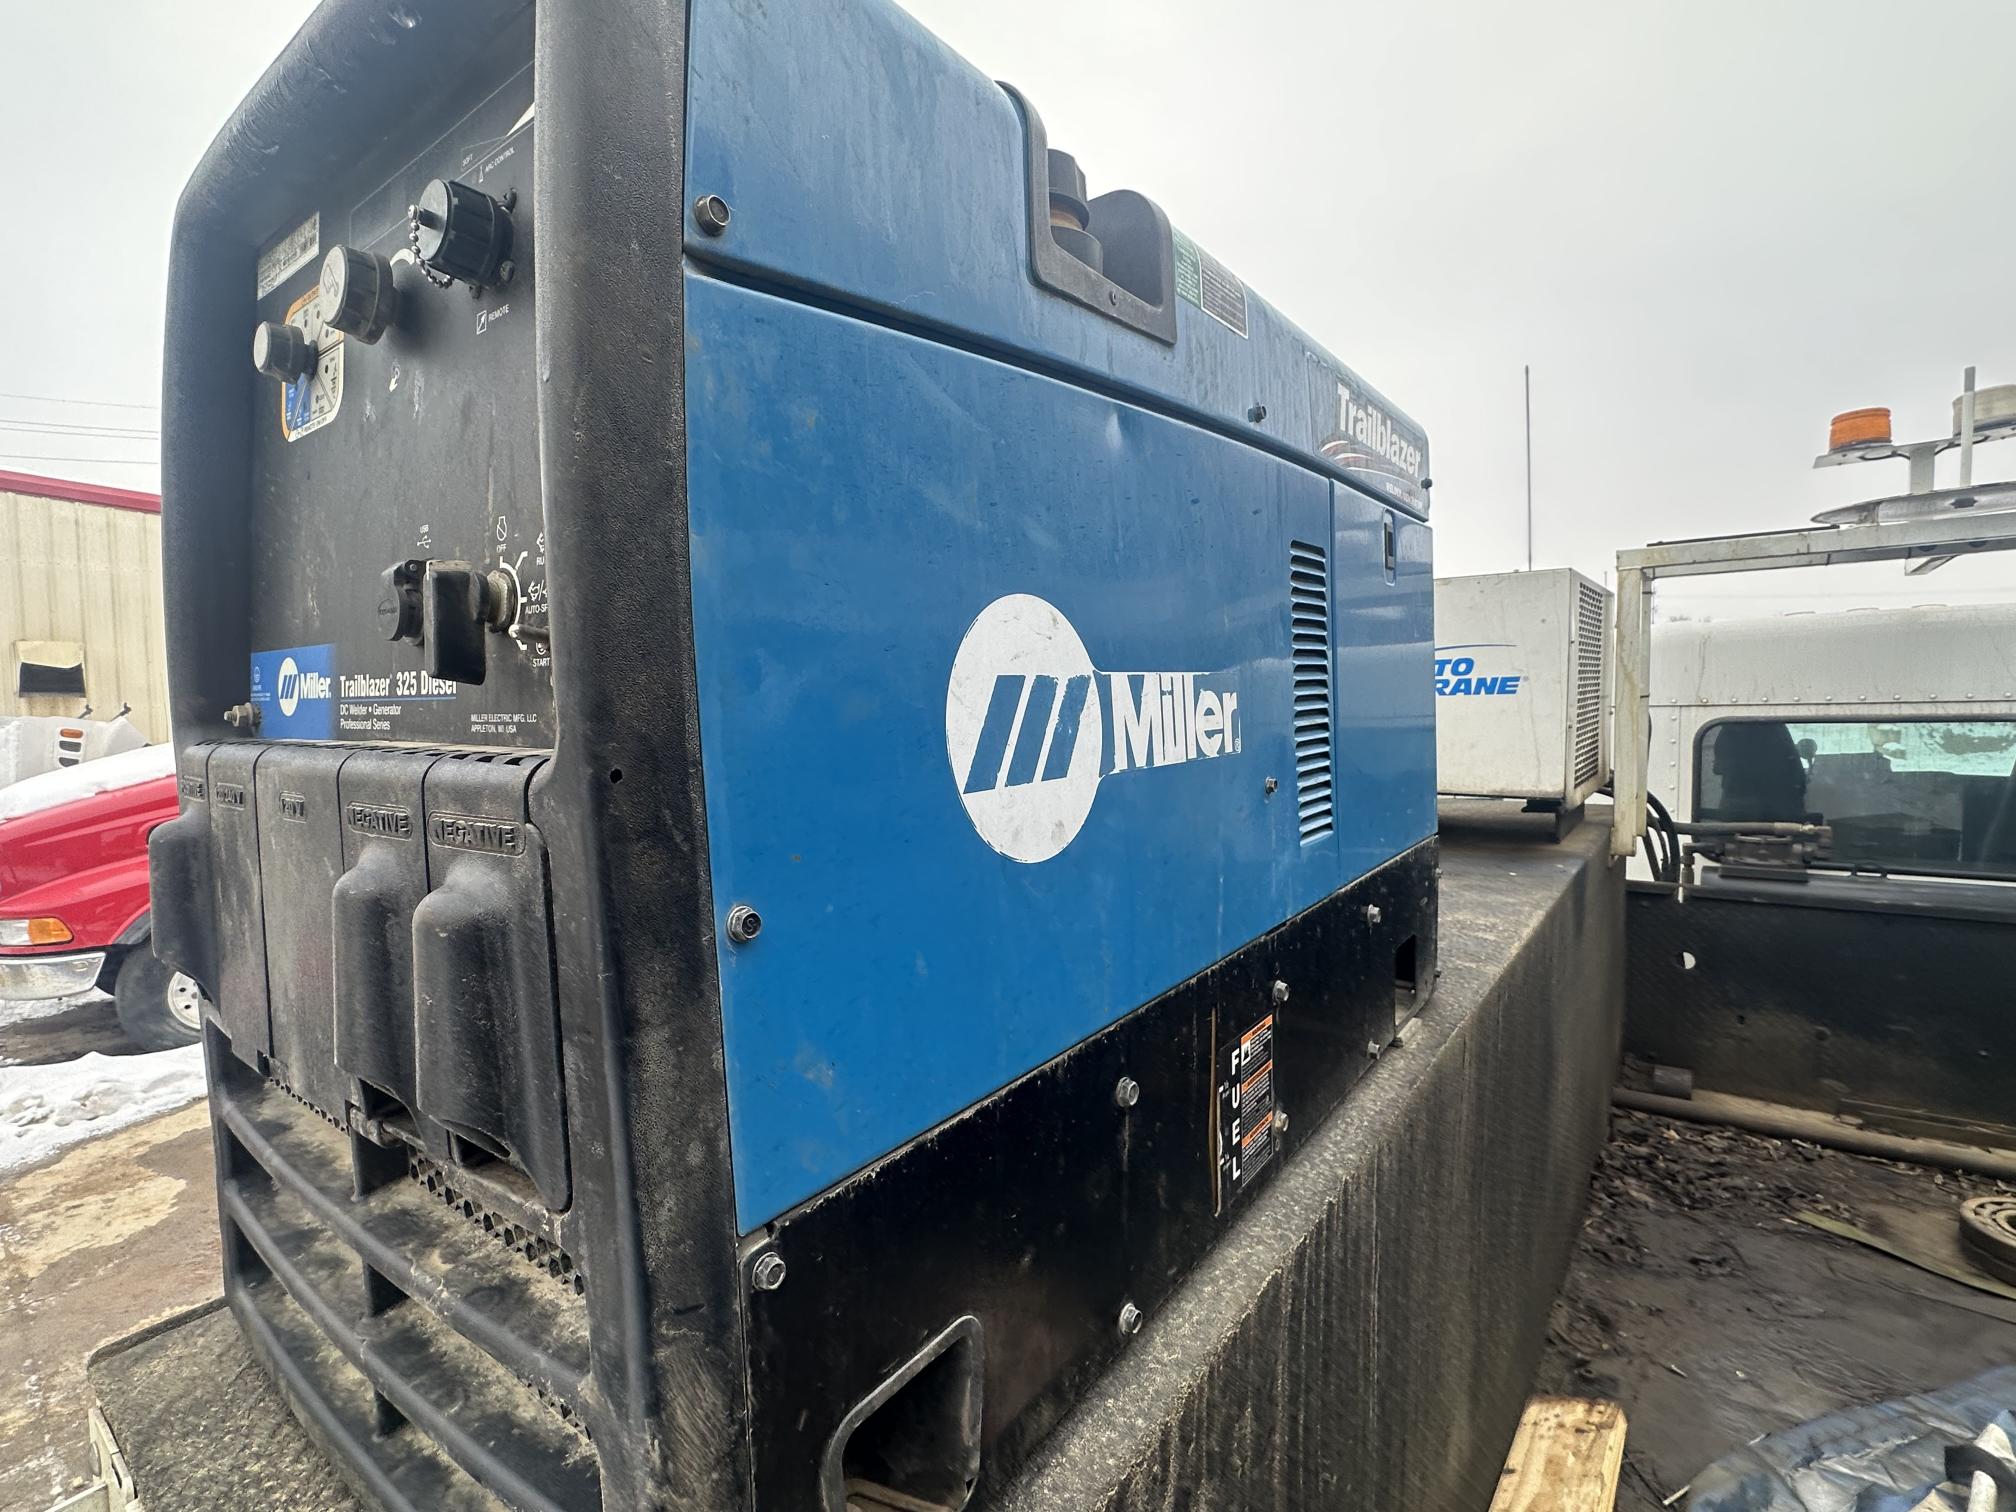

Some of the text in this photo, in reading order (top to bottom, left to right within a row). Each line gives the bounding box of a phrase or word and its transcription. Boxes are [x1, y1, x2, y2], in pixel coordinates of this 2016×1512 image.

[488, 303, 510, 321] REMOTE
[1337, 382, 1421, 478] Trailblazer
[419, 524, 429, 533] USB
[496, 544, 507, 553] OFF
[536, 556, 545, 566] RU
[532, 657, 550, 667] START
[1434, 657, 1475, 677] TO
[300, 672, 331, 699] Miller
[339, 670, 457, 698] Trailblazer 325 Diesel
[1434, 676, 1521, 696] RANE
[339, 703, 402, 715] DC Welder Generator
[470, 713, 488, 722] MILLER
[488, 713, 513, 723] ELECTRIC
[526, 713, 538, 723] LLC
[339, 718, 391, 731] Professional Series
[505, 724, 517, 734] USA
[1109, 672, 1239, 772] Miller
[348, 807, 411, 836] NEGATIVE
[432, 817, 517, 851] NEGATIVE
[1231, 1047, 1242, 1181] FUEL
